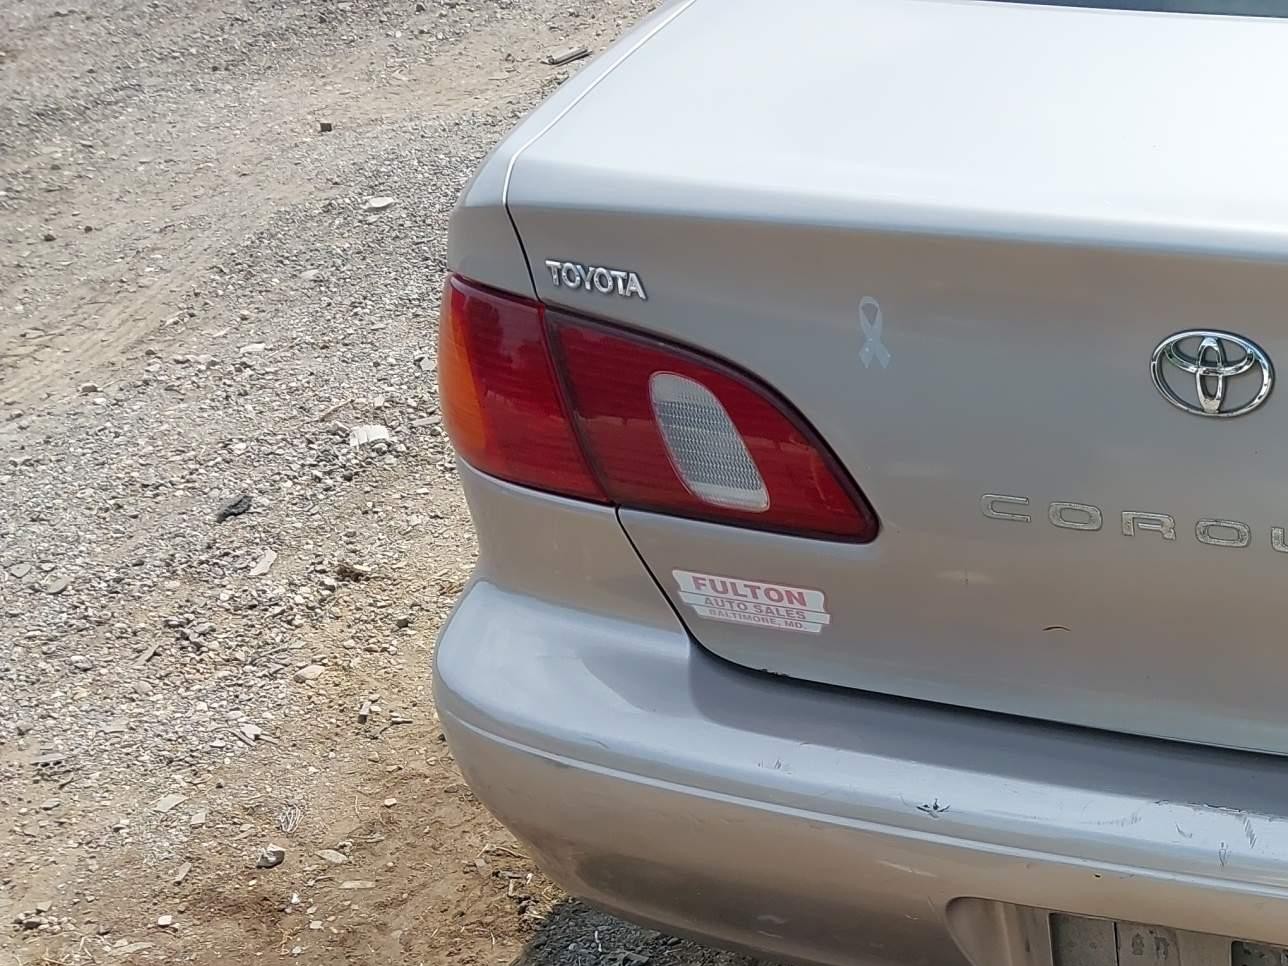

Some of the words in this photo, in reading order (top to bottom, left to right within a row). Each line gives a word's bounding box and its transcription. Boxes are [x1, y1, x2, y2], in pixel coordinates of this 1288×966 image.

[544, 259, 648, 300] TOYOTA
[691, 575, 808, 608] FULTON
[704, 596, 748, 613] AUTO
[753, 602, 807, 620] SALES
